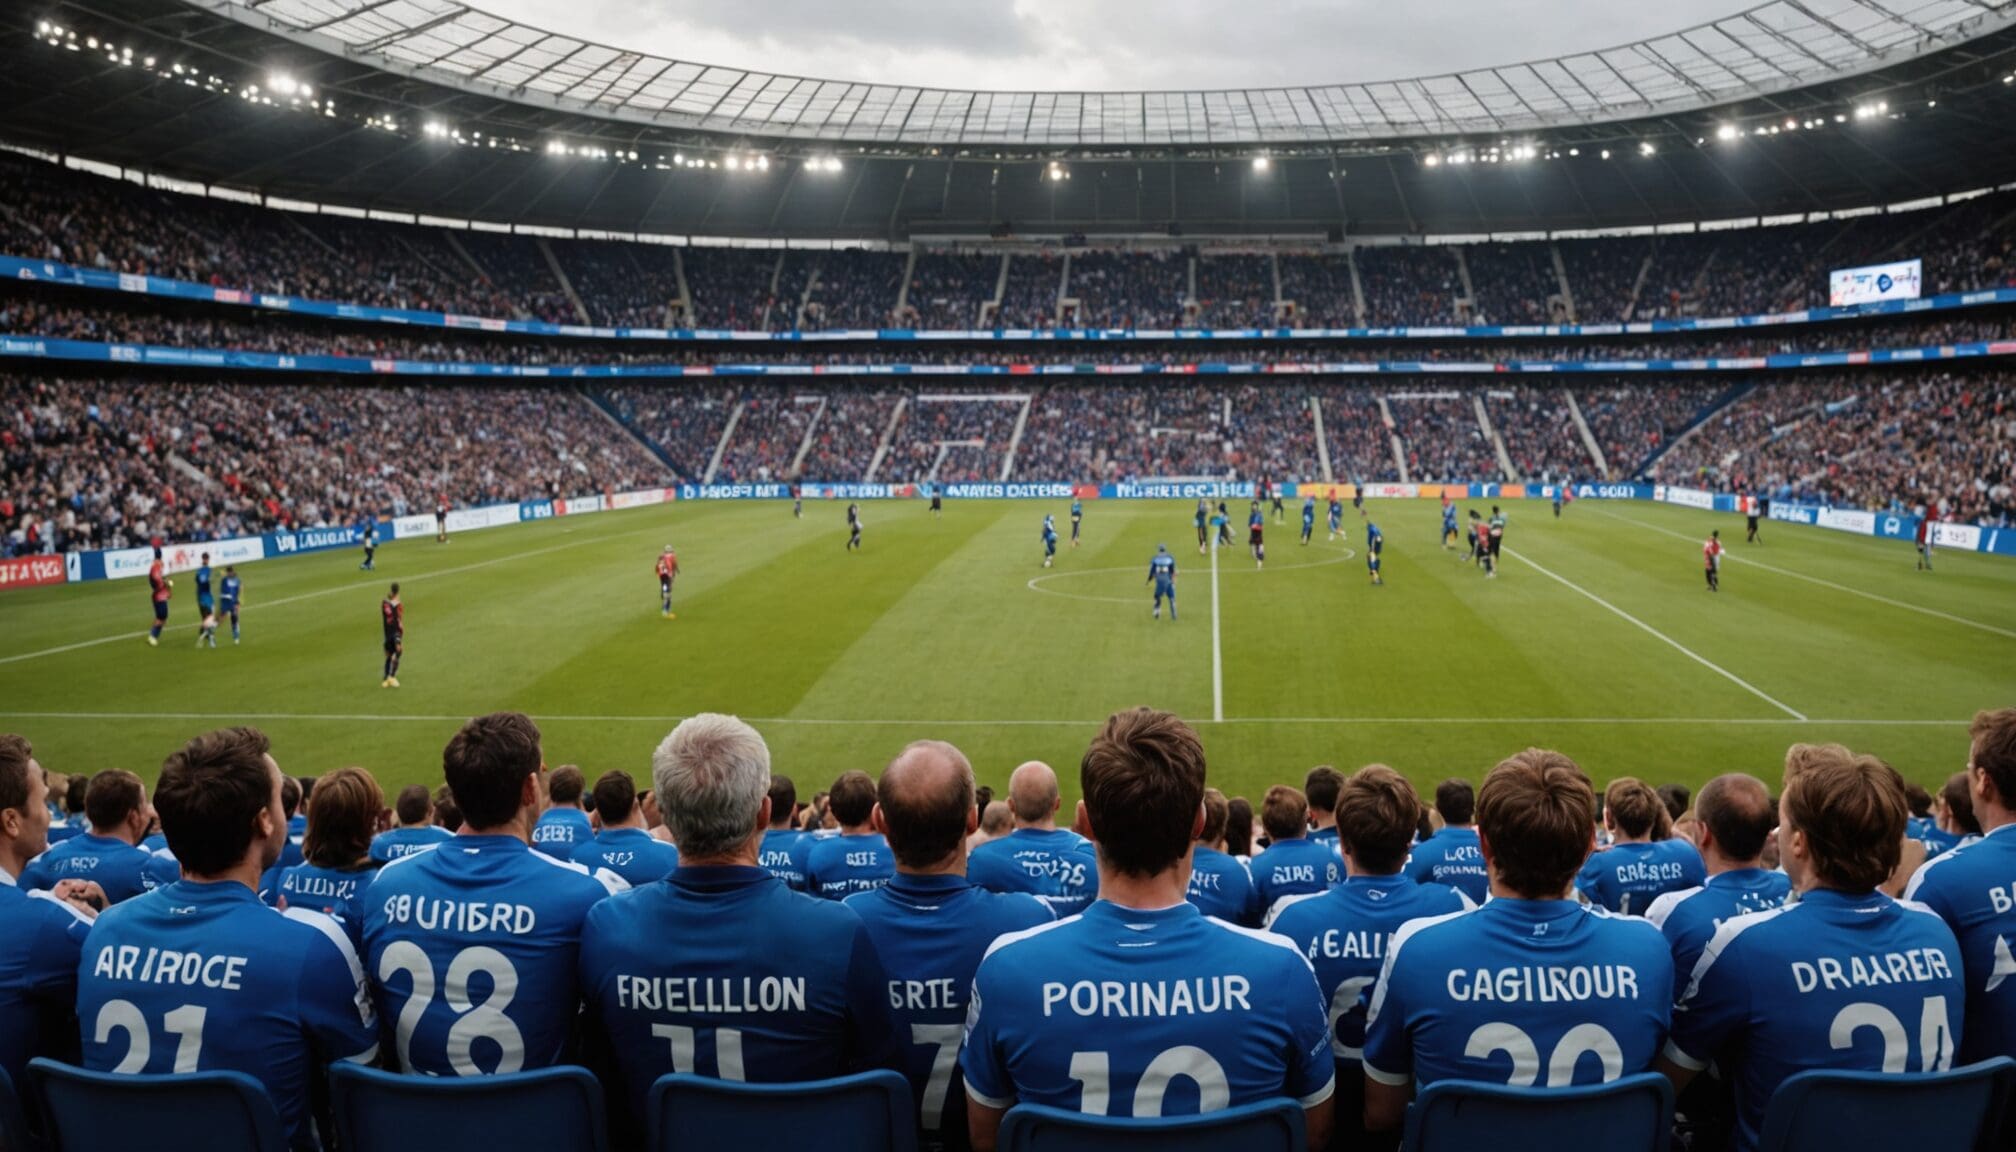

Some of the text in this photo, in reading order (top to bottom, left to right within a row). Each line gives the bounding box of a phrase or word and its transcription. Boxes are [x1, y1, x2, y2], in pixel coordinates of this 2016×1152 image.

[95, 999, 207, 1074] 21
[379, 940, 525, 1077] 28
[1043, 975, 1251, 1017] PORINAUR
[911, 1023, 963, 1130] 7
